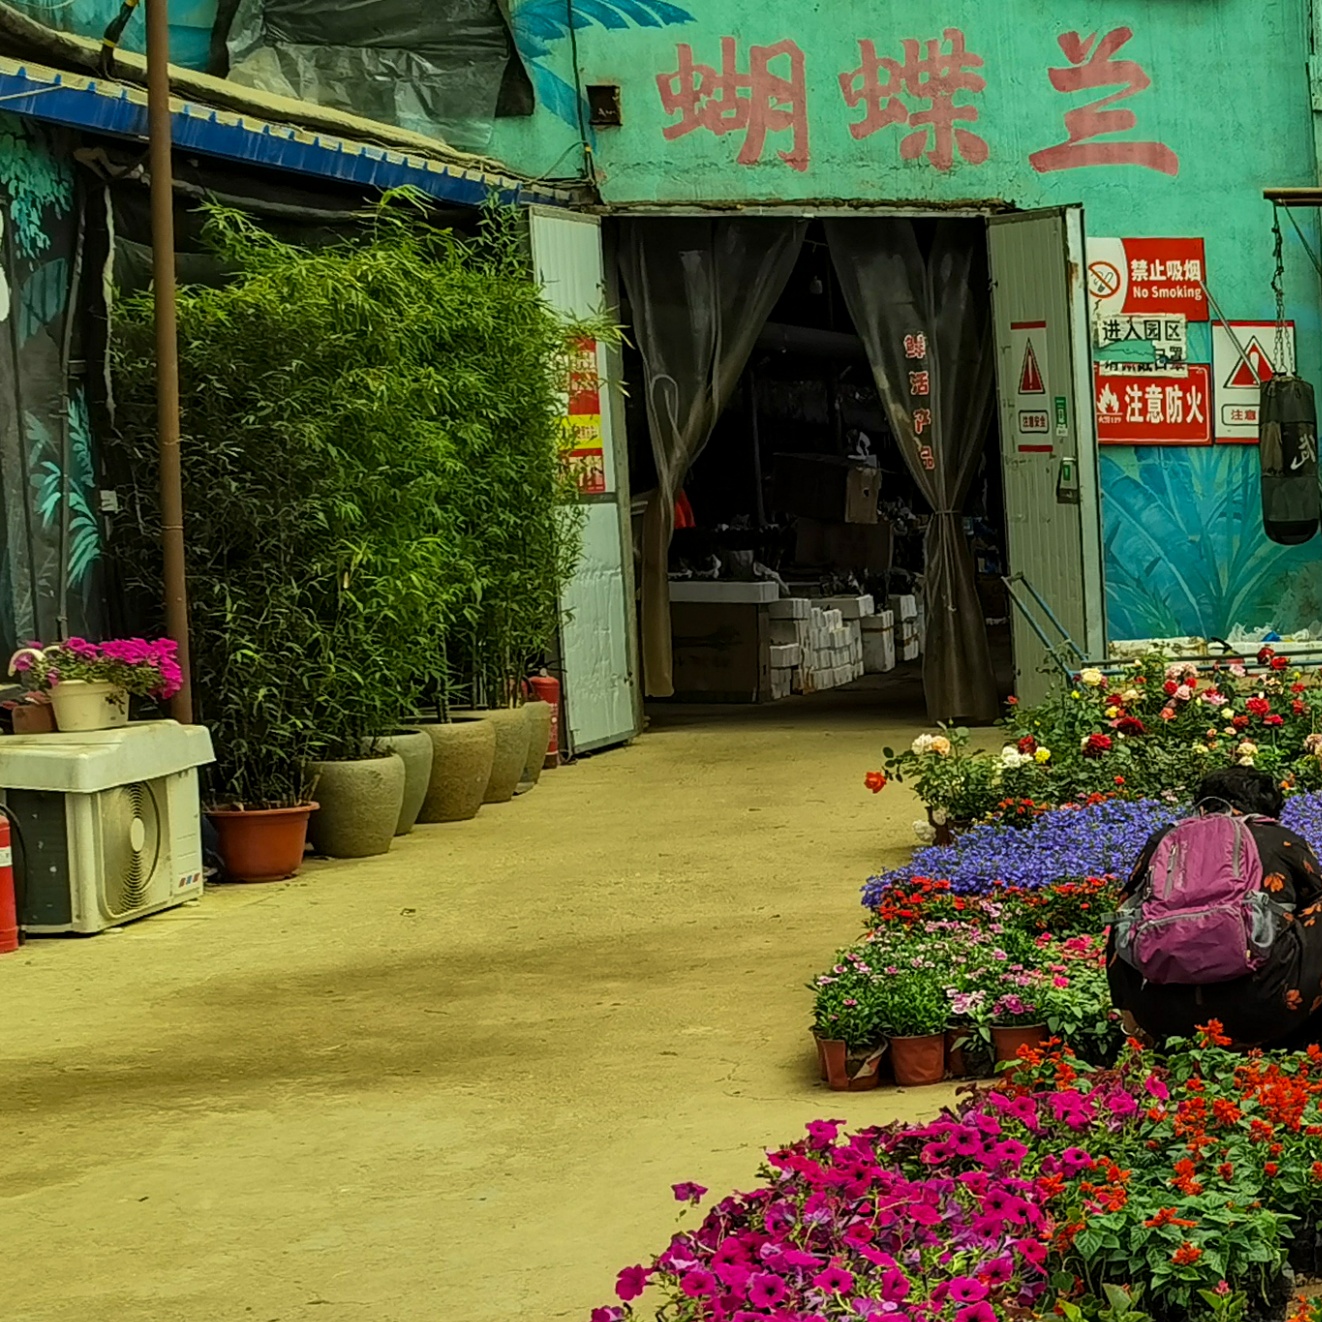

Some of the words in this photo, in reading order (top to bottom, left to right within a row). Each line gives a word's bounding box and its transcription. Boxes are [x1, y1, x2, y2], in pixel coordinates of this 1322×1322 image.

[654, 26, 1179, 177] 蝴蝶兰
[1130, 259, 1201, 282] 禁止吸烟
[1133, 286, 1149, 298] No
[1151, 285, 1202, 300] Smoking
[1102, 316, 1182, 341] 进入园区
[1124, 383, 1204, 424] 注意防火
[1022, 415, 1046, 428] 注意安全
